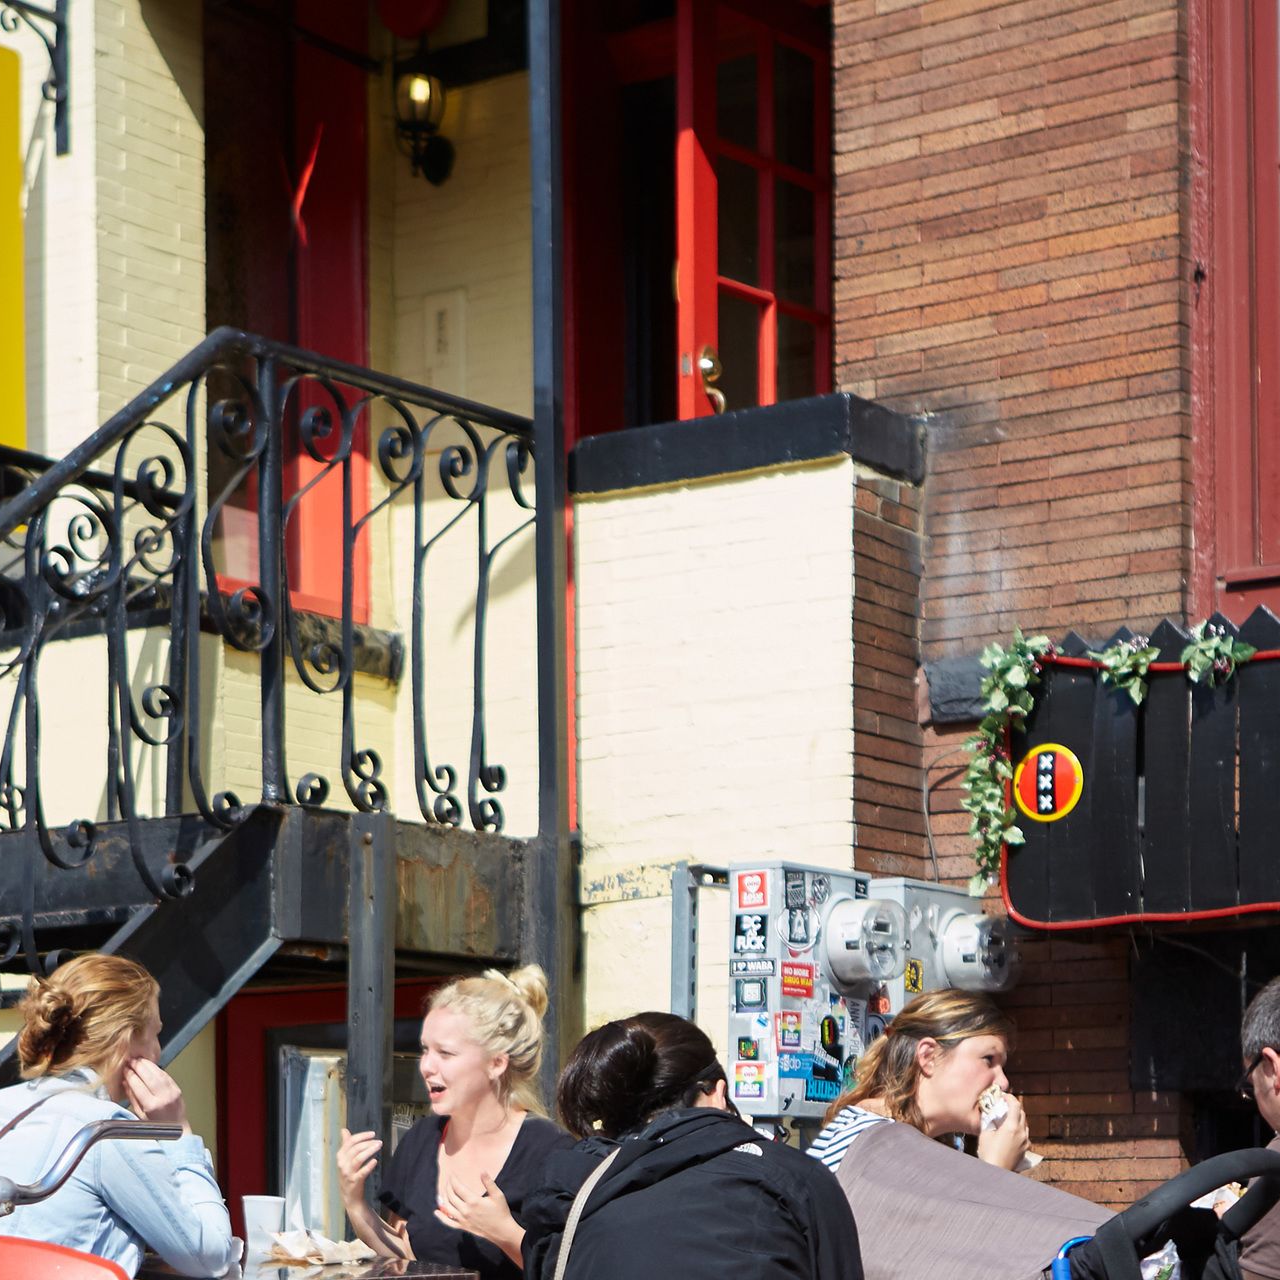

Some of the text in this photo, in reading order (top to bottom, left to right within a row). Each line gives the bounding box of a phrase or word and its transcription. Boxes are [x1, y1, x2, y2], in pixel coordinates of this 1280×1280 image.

[748, 960, 773, 971] WABA
[784, 966, 794, 975] NO
[794, 967, 810, 978] MORE
